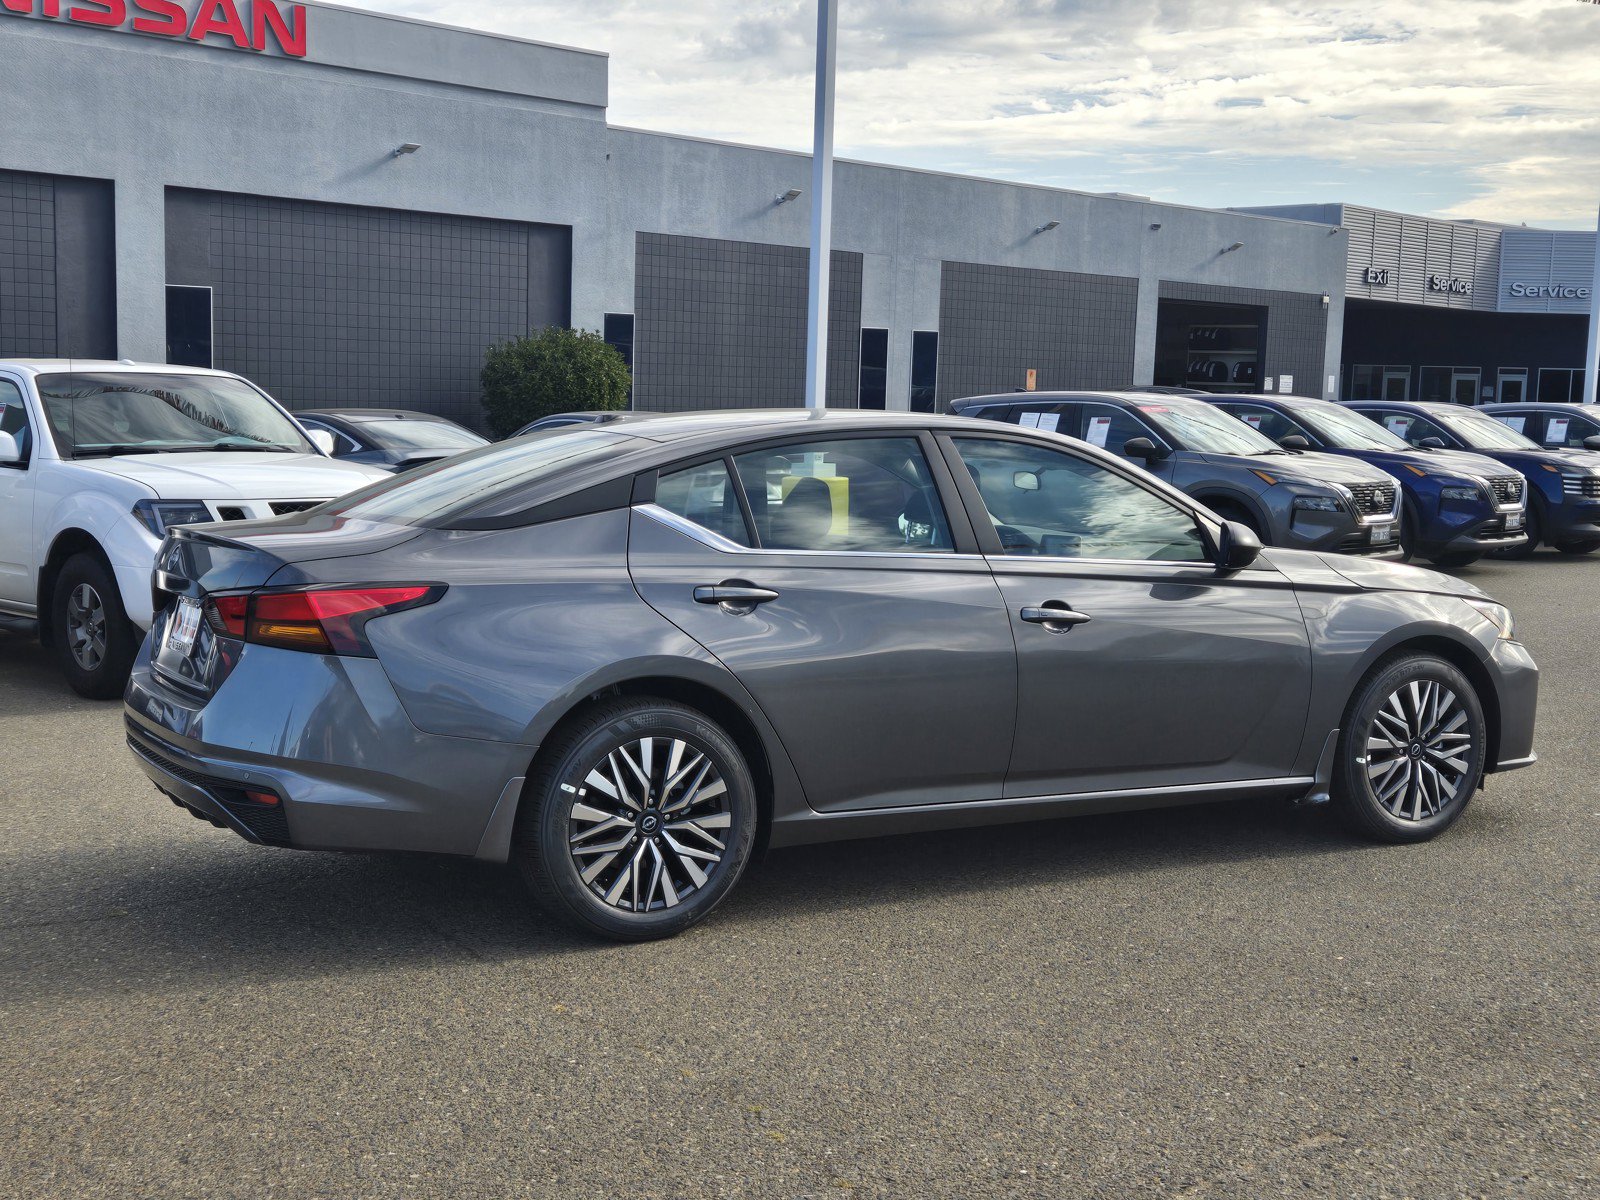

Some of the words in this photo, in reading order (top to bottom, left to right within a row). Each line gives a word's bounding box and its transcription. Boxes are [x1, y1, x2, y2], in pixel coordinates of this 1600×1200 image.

[1, 0, 306, 57] SSAN
[1432, 274, 1471, 293] Service
[1510, 282, 1590, 299] Service
